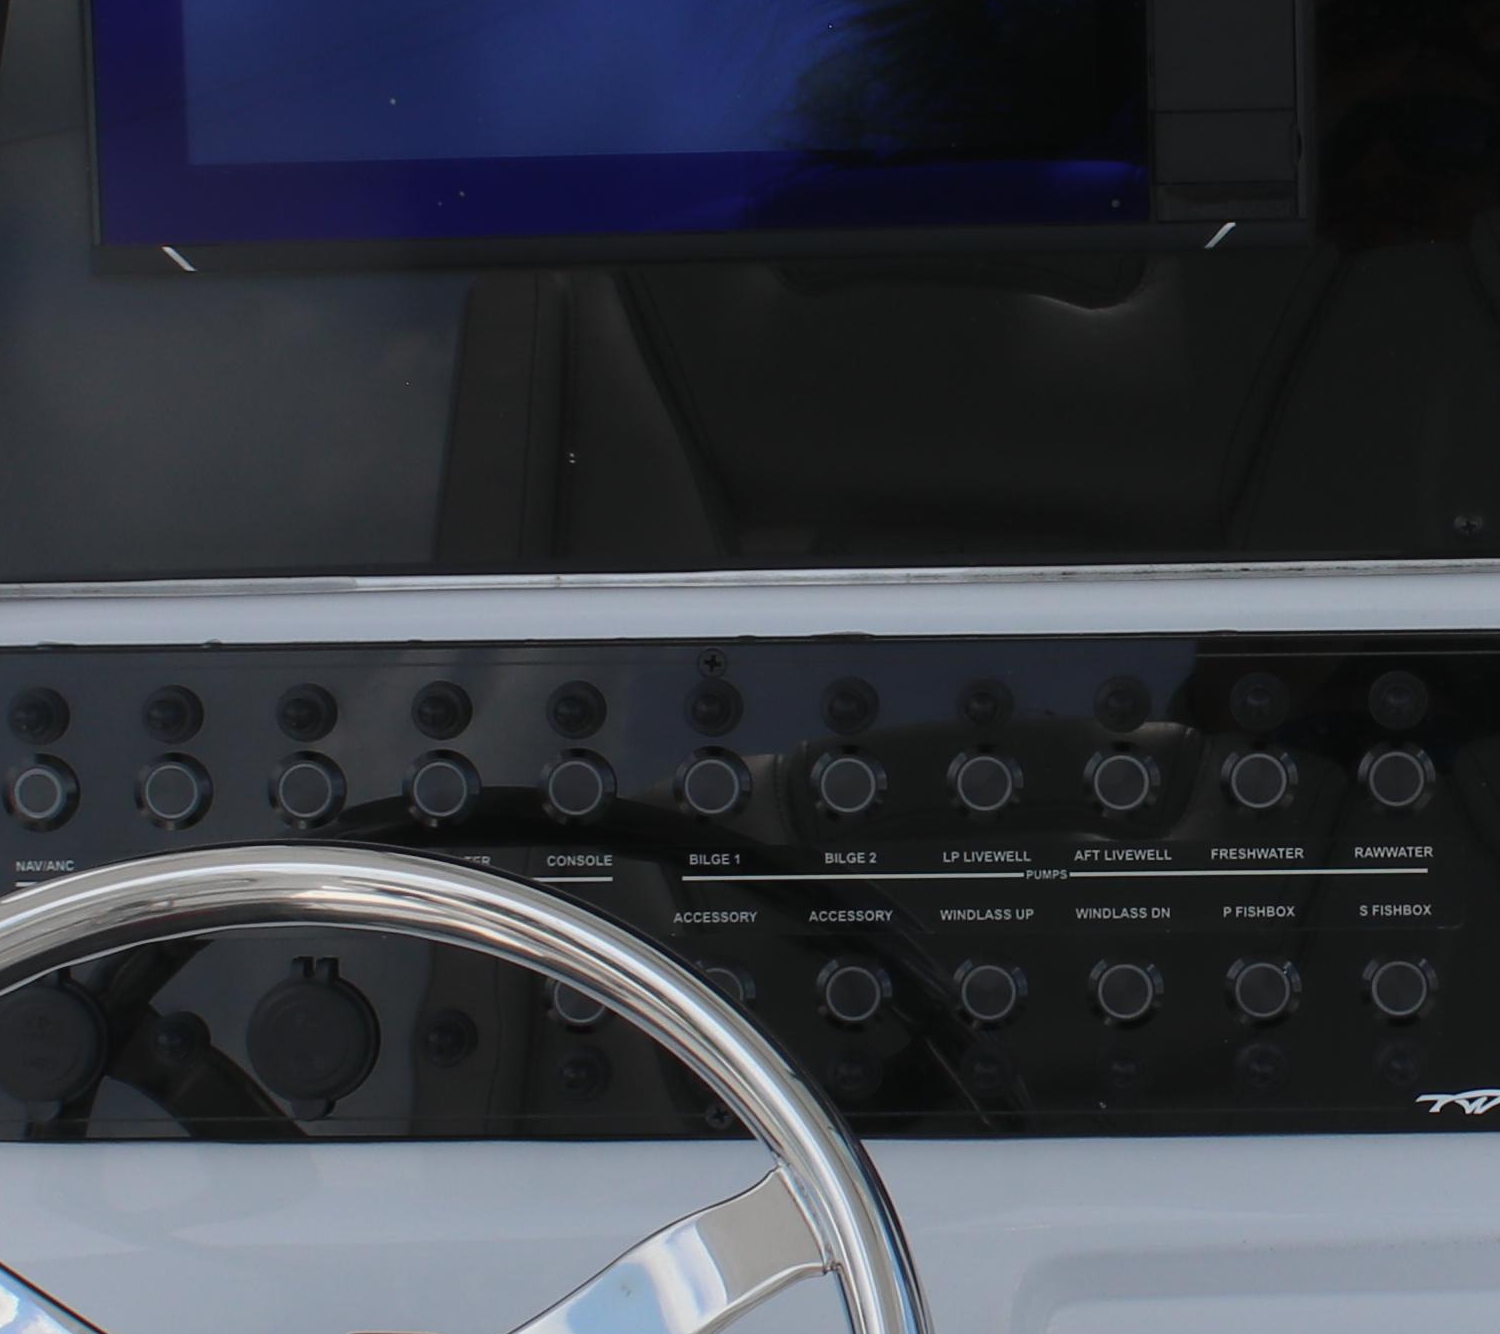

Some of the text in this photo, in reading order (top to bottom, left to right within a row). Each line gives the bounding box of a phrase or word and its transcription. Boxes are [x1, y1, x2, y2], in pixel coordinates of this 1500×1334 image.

[824, 852, 877, 864] BILGE 2
[942, 850, 1032, 863] LP LIVEWELL
[1073, 849, 1172, 861] AFT LIVEWELL
[1210, 847, 1305, 860] FRESHWATER
[1354, 845, 1434, 858] RAWWATER
[15, 860, 75, 872] NAV/ANC
[546, 854, 613, 867] CONSOLE
[688, 853, 741, 866] BILGE 1
[1025, 869, 1069, 880] PUMPS
[940, 908, 1035, 922] WINDLASS UP
[1075, 907, 1171, 920] WINDLASS DN
[1222, 905, 1296, 918] P FISHBOX
[1359, 903, 1432, 916] S FISHBOX
[673, 911, 758, 924] ACCESSORY
[808, 910, 893, 923] ACCESSORY
